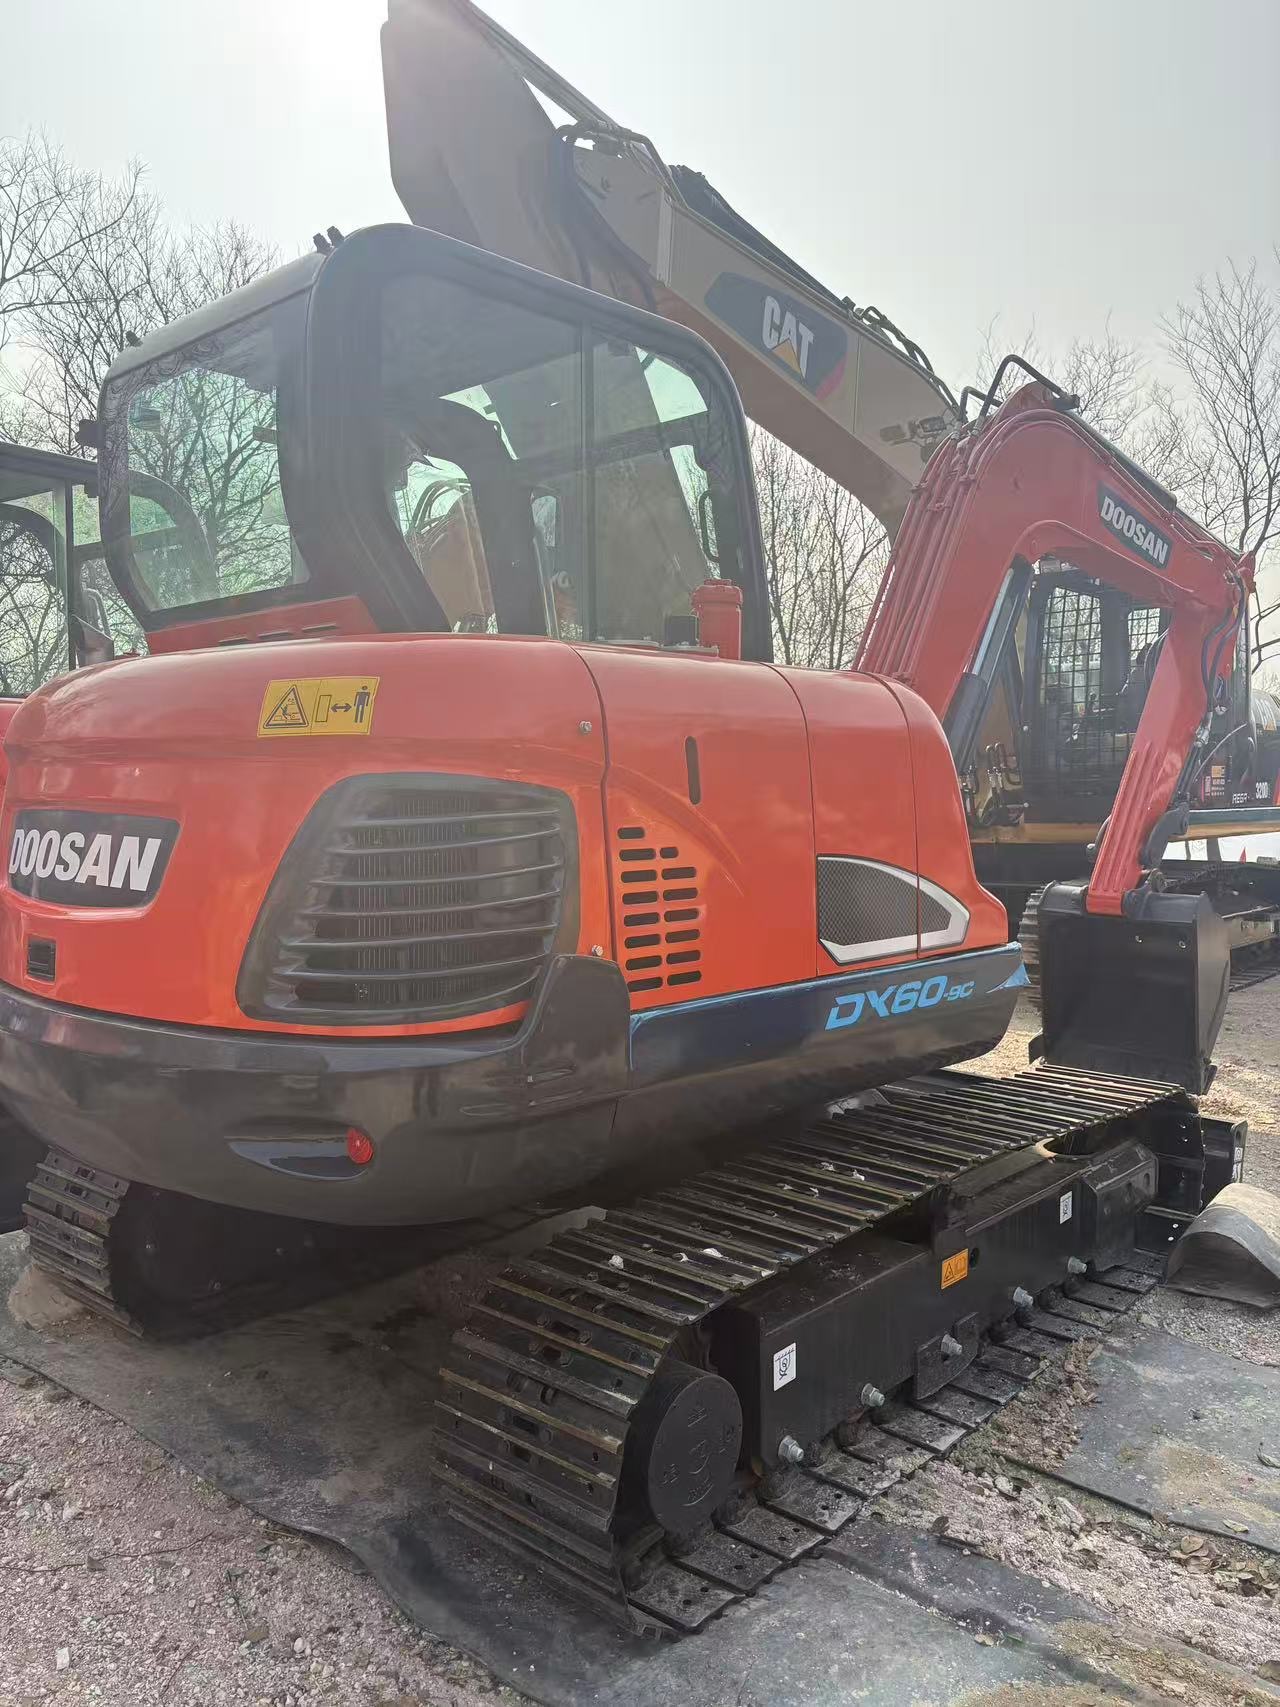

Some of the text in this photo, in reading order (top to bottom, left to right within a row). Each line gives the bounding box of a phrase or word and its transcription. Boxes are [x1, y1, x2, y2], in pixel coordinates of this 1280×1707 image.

[763, 295, 814, 378] CAT
[1101, 496, 1168, 564] DOOSAN
[9, 829, 162, 891] DOOSAN
